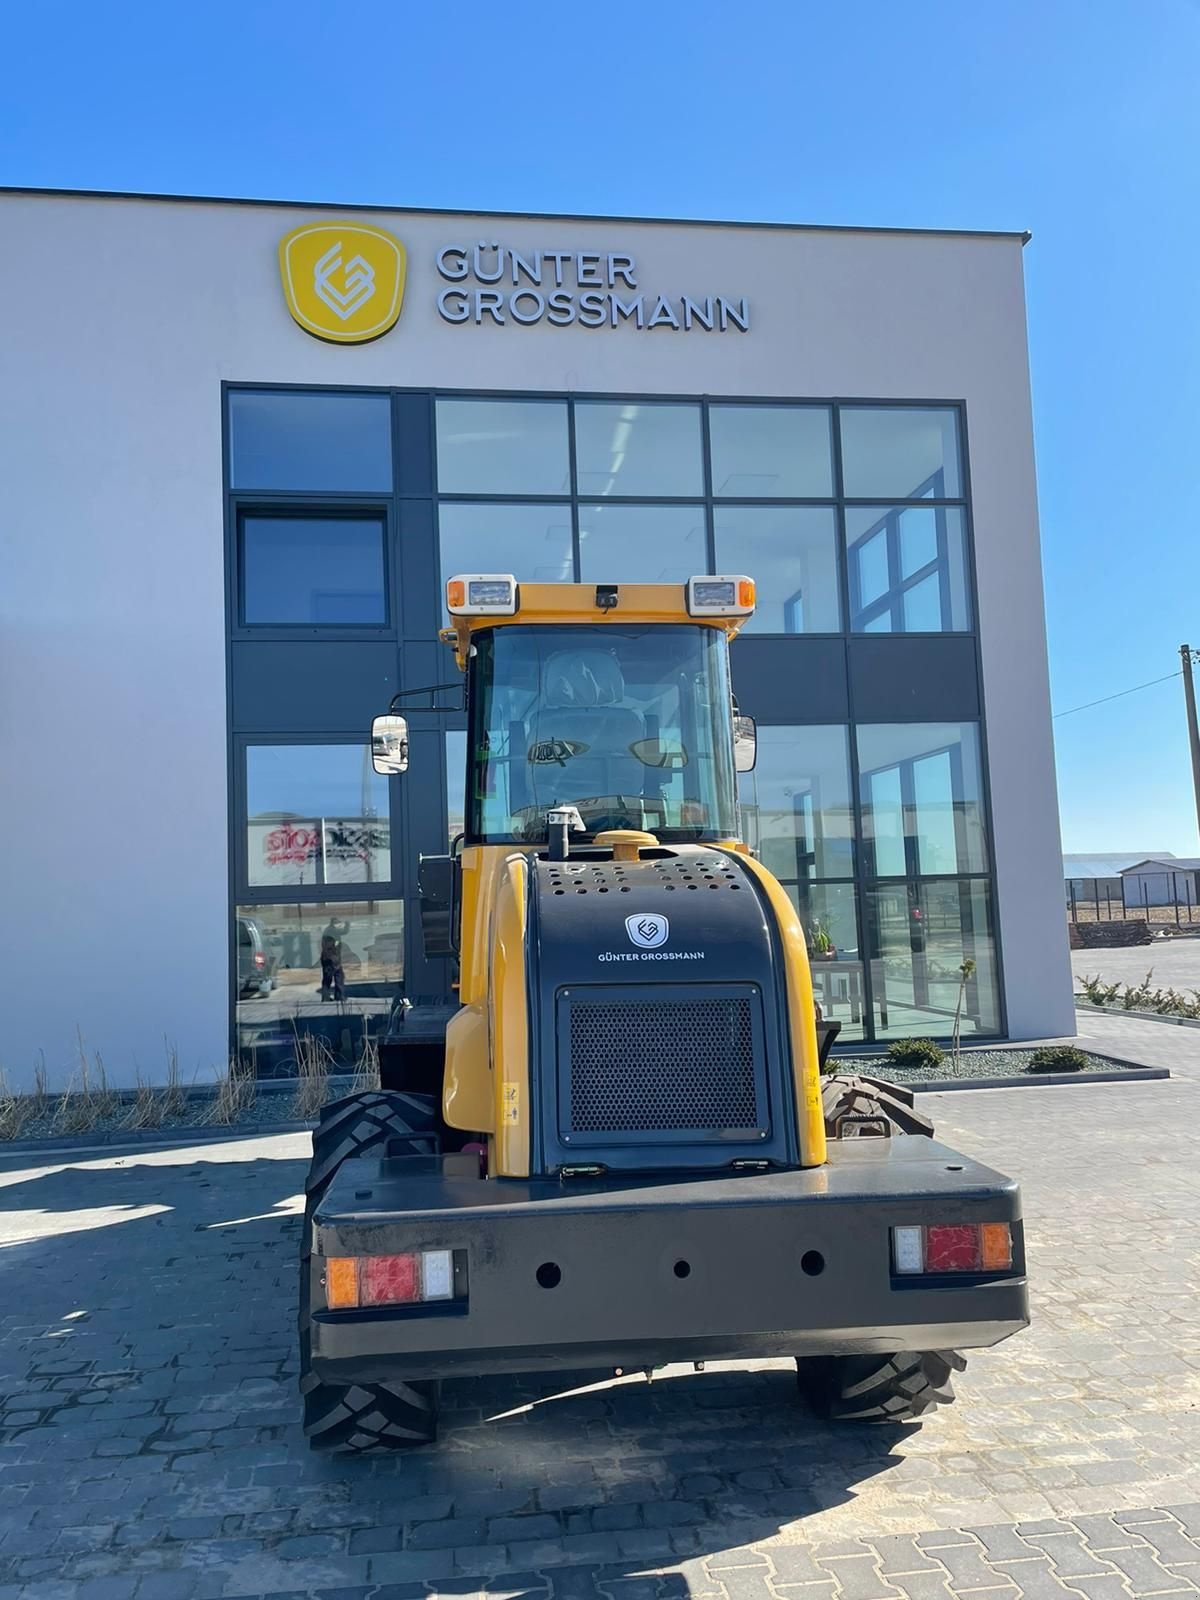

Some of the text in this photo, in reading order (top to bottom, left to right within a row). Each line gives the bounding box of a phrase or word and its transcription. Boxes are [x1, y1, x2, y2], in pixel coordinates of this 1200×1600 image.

[436, 240, 638, 288] GÜNTER
[437, 286, 750, 332] GROSSMANN
[598, 951, 706, 962] GÜNTER GROSSMANN
